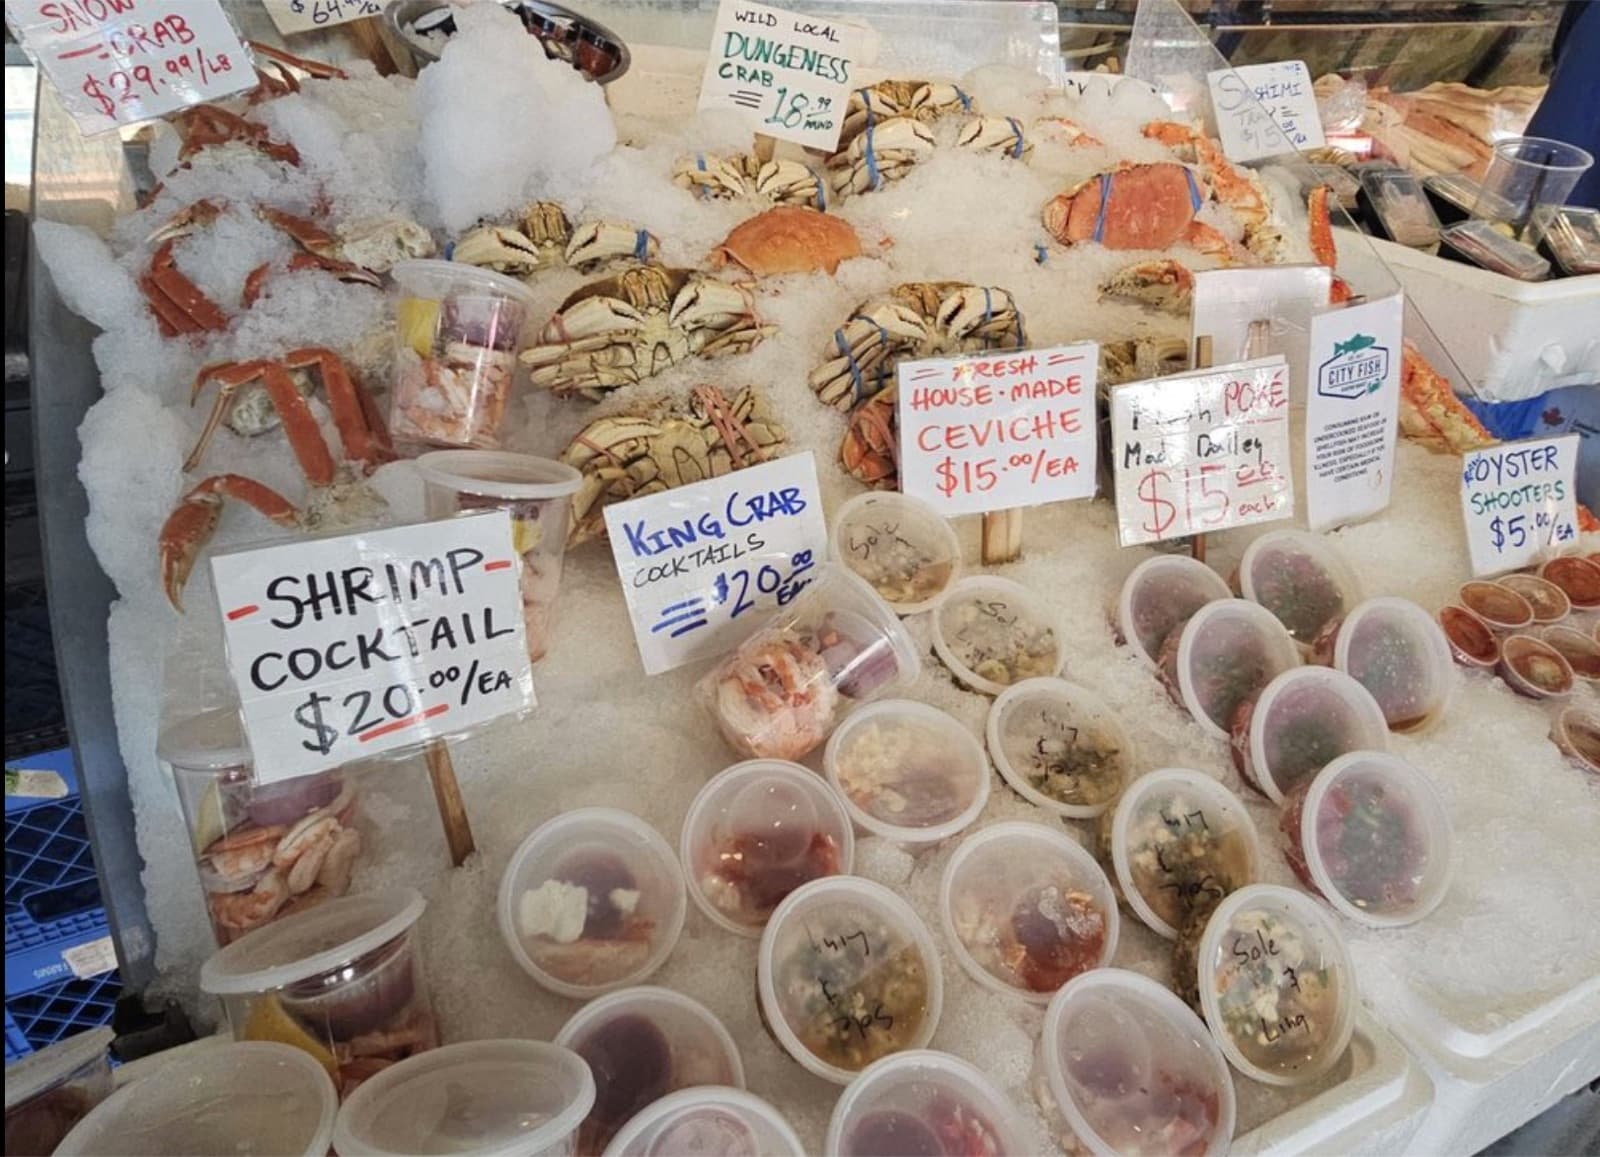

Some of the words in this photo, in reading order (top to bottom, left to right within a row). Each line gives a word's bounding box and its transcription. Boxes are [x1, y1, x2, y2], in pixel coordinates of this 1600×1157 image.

[40, 0, 134, 33] SNOW
[111, 14, 195, 55] CRAB
[735, 10, 777, 27] WILD
[794, 22, 840, 43] LOCAL
[718, 62, 773, 87] CRAB
[724, 31, 851, 85] DUNGENESS
[1218, 73, 1302, 111] SSHIMI
[1328, 366, 1354, 385] CITY
[1358, 360, 1381, 377] FISH
[917, 408, 1082, 452] CEVICHE
[1124, 438, 1170, 469] Mad
[1475, 445, 1558, 485] OYSTER
[1239, 496, 1275, 516] each
[1471, 480, 1565, 515] SHOOTERS
[623, 513, 726, 556] KING
[726, 488, 806, 526] CRAB
[633, 533, 765, 588] COCKTAILS
[266, 548, 484, 629] SHRIMP
[250, 607, 515, 691] COCKTAIL
[1233, 929, 1280, 965] Sole
